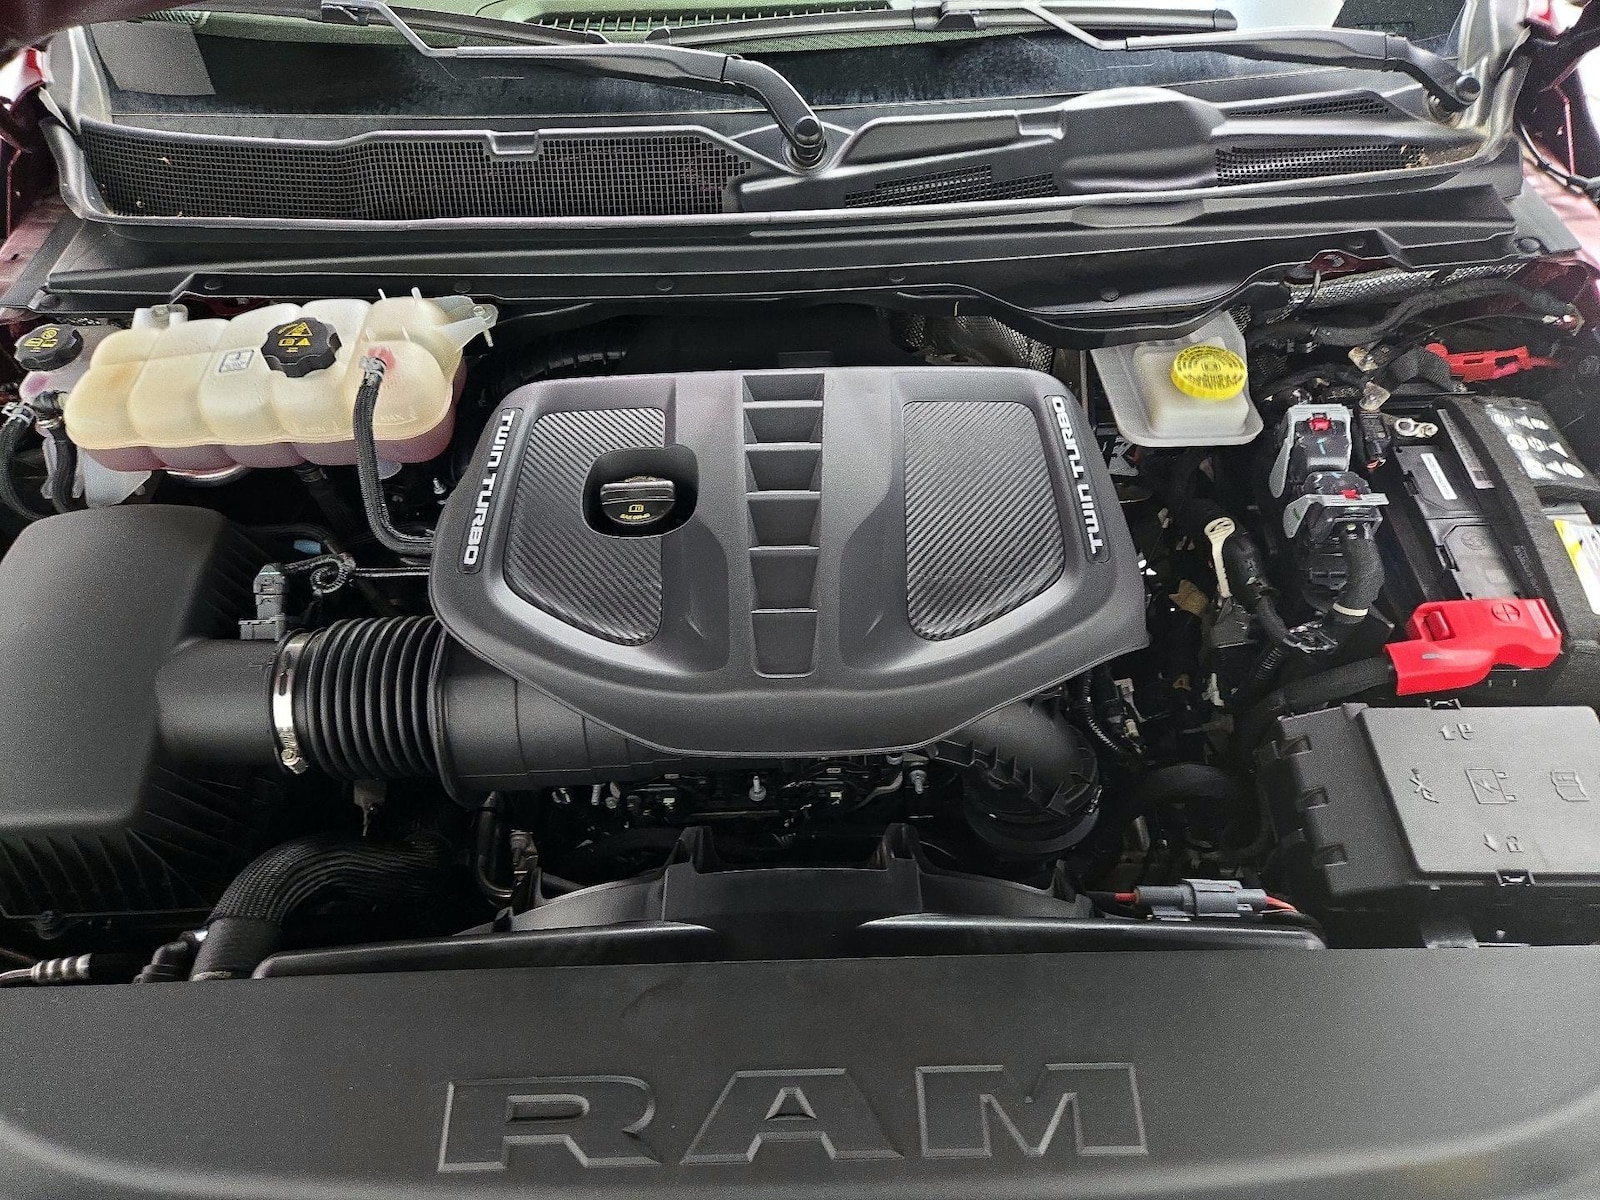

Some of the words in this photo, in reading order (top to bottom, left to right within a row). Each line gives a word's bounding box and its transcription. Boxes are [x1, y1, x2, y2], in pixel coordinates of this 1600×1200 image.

[487, 410, 516, 468] TWIN
[1051, 396, 1085, 479] TURBO
[463, 472, 497, 565] TURBO
[1076, 483, 1104, 554] TWIN
[437, 1062, 1149, 1173] RAM
